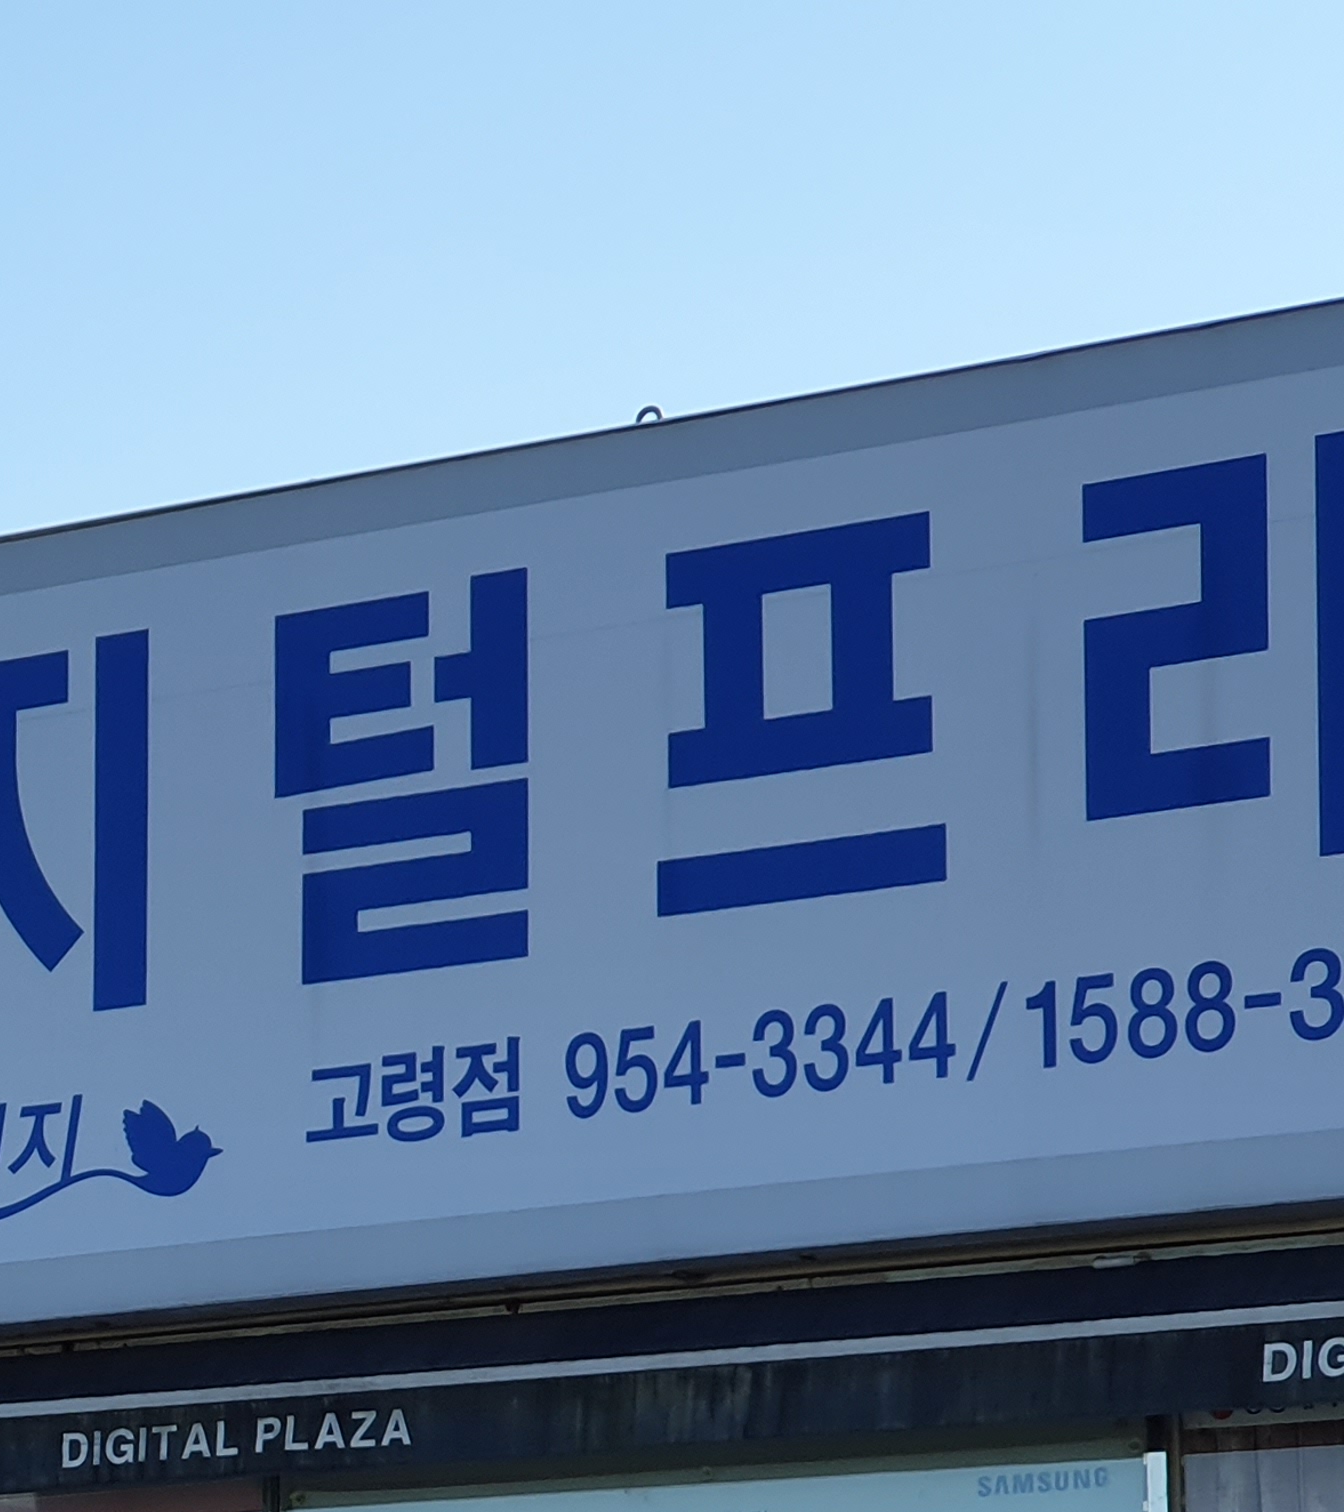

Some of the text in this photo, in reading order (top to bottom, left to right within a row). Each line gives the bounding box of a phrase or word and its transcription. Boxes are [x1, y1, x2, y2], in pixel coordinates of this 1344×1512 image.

[306, 1036, 521, 1143] 고령점
[60, 1406, 413, 1470] DIGITAL PLAZA
[977, 1466, 1108, 1498] SAMSUNG
